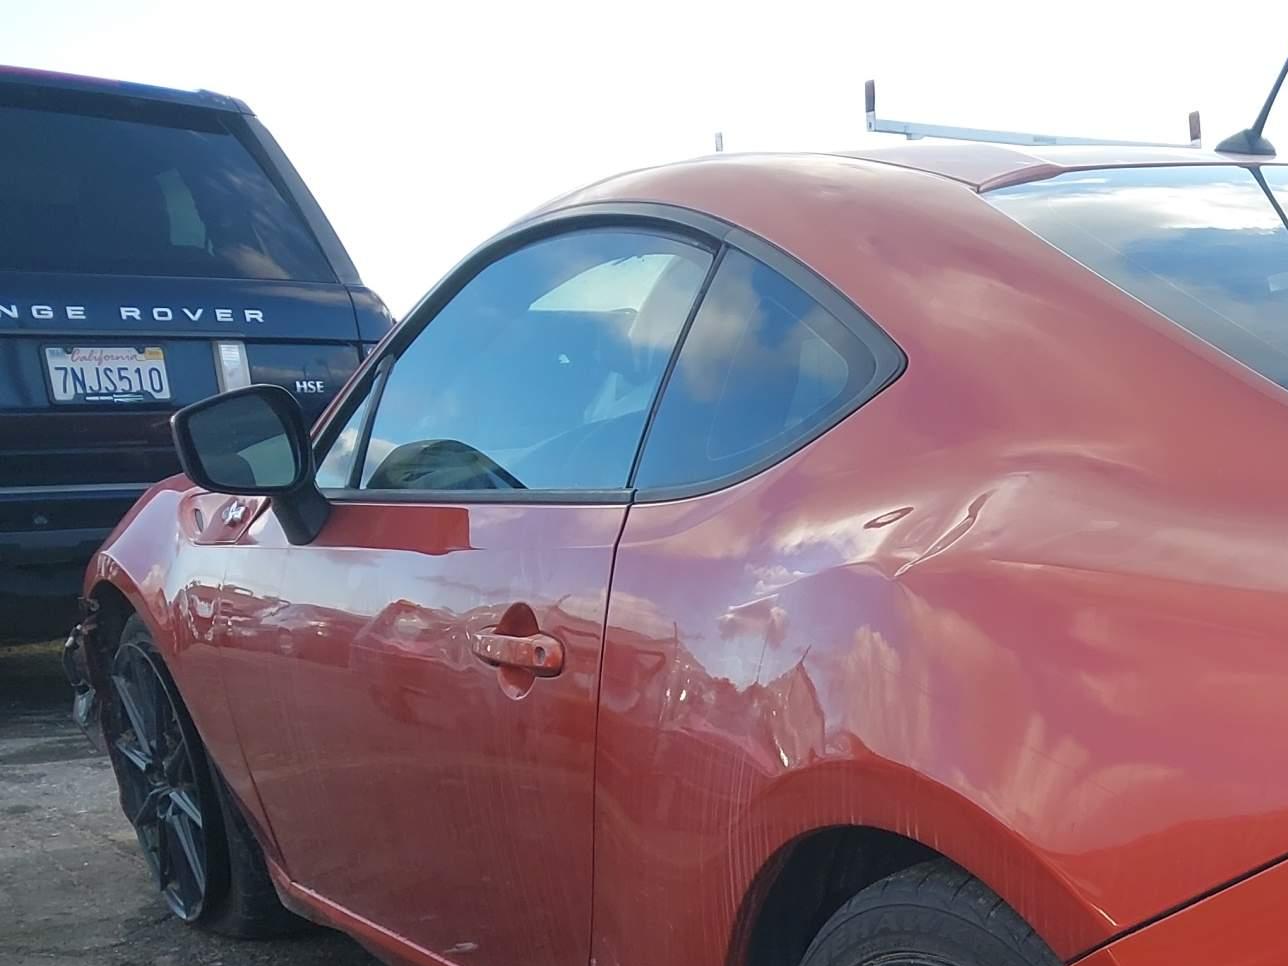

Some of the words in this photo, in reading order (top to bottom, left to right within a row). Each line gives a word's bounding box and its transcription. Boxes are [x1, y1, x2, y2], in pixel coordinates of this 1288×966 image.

[119, 306, 265, 323] ROVER
[70, 349, 145, 365] California
[54, 367, 164, 394] 7NJS510
[295, 380, 325, 393] HSE
